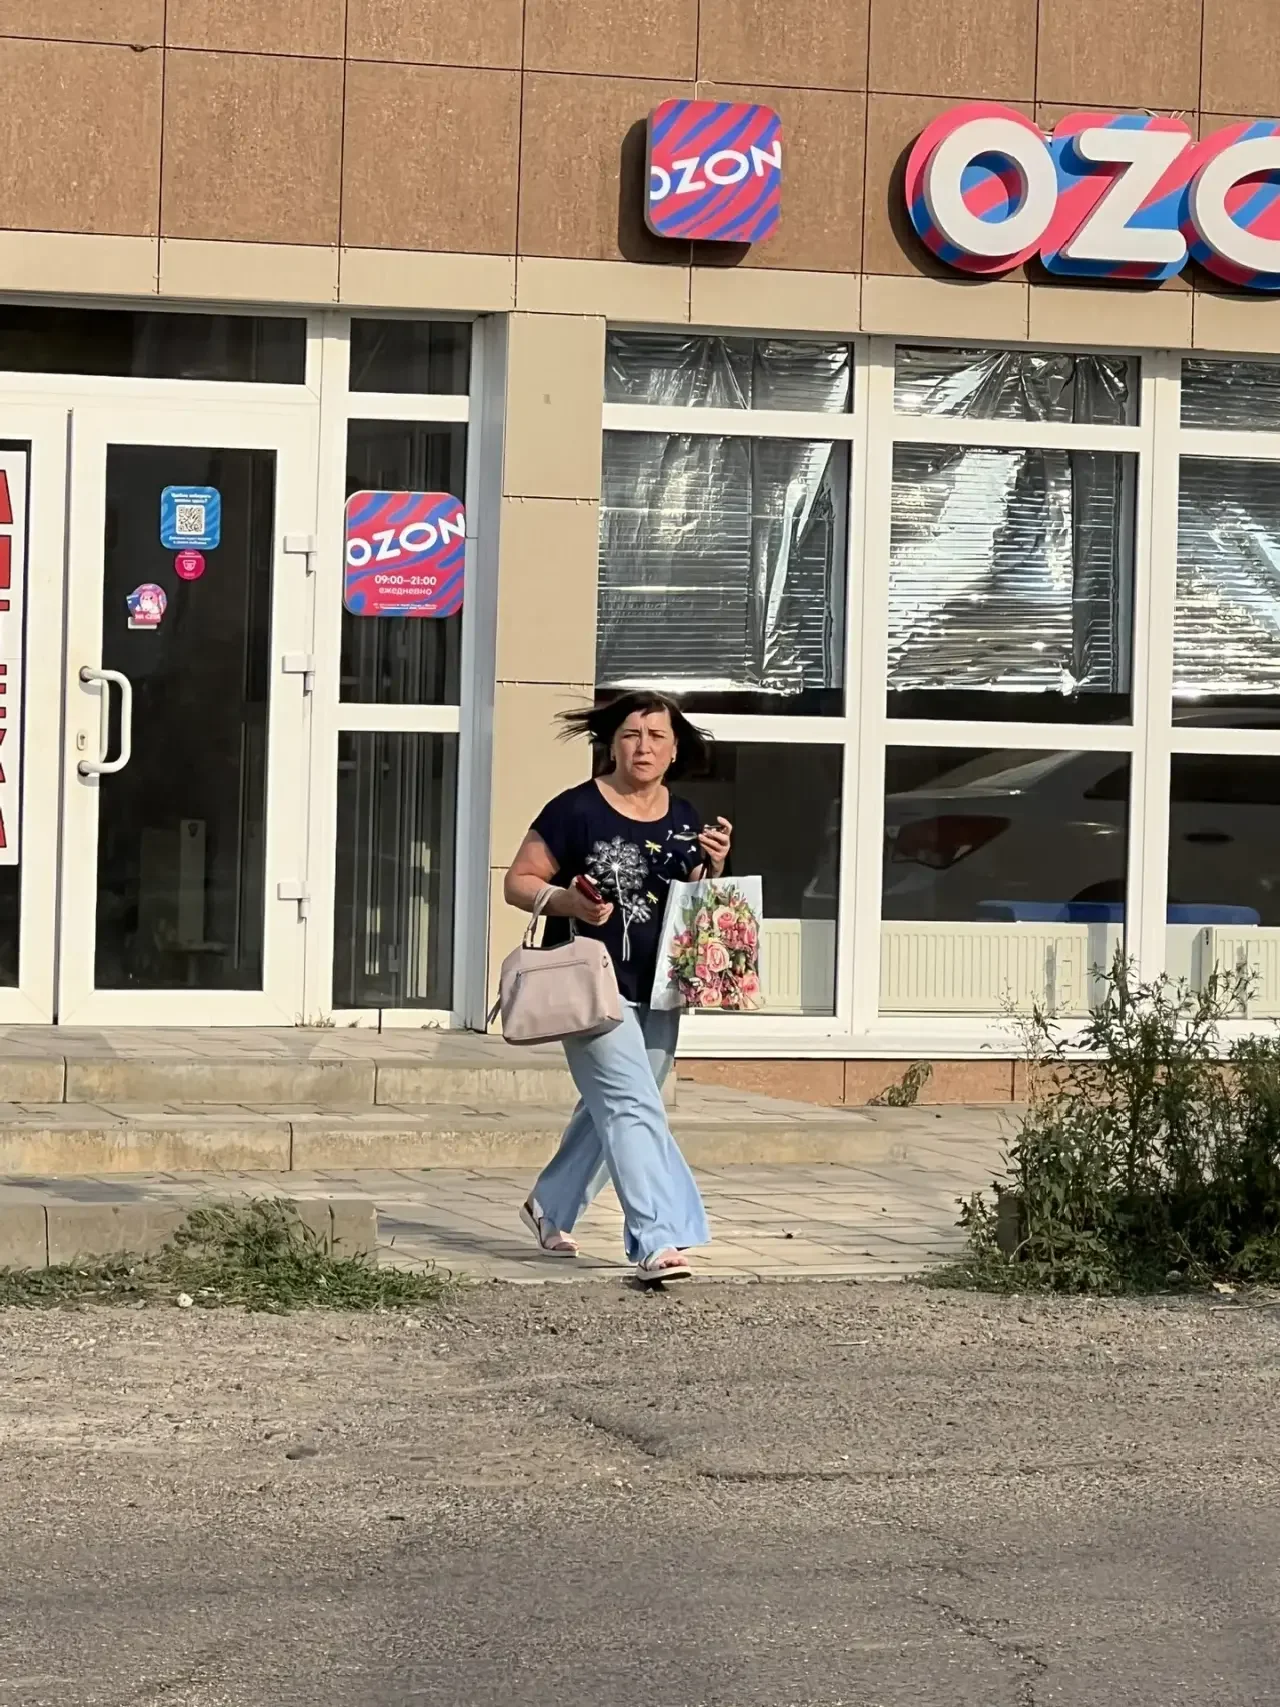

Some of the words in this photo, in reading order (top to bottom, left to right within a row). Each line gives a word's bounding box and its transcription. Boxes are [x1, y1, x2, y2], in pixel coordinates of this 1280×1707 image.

[650, 140, 782, 201] OZON
[346, 512, 465, 567] OZON
[378, 587, 433, 596] ежедневно
